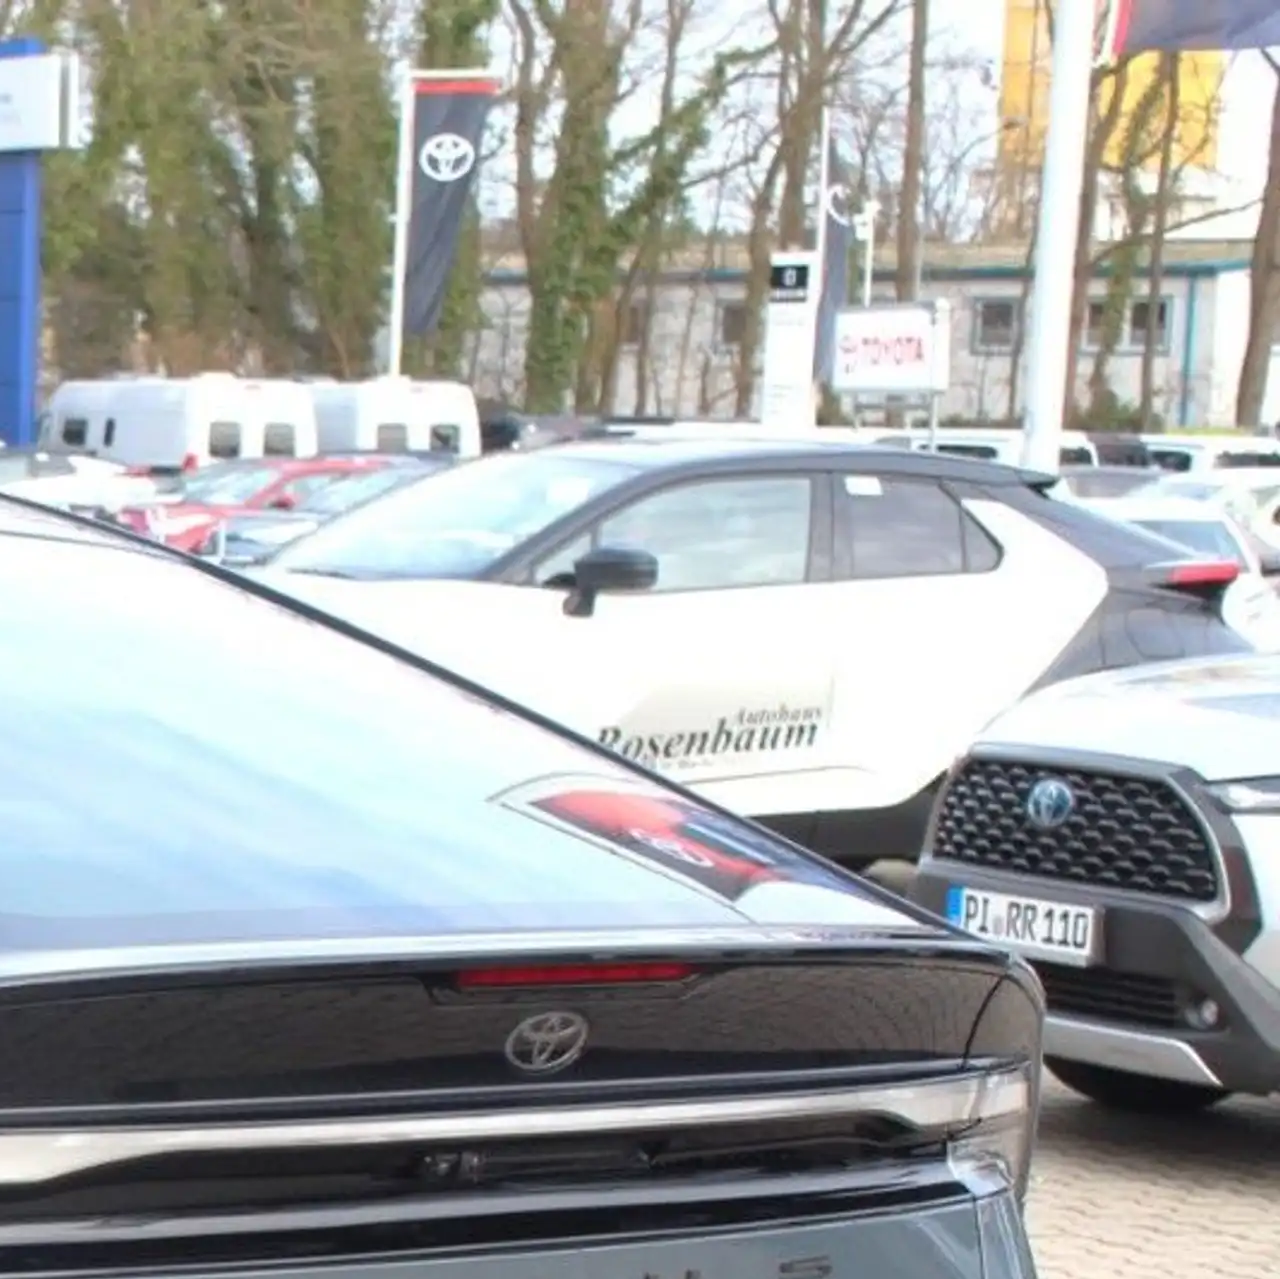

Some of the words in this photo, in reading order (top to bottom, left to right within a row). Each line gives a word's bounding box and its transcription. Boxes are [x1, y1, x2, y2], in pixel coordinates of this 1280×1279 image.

[861, 336, 924, 366] TOYOTA
[737, 704, 824, 726] Autohaus
[597, 716, 818, 761] Rosenbaum
[964, 895, 989, 933] PI
[1042, 907, 1089, 949] 110
